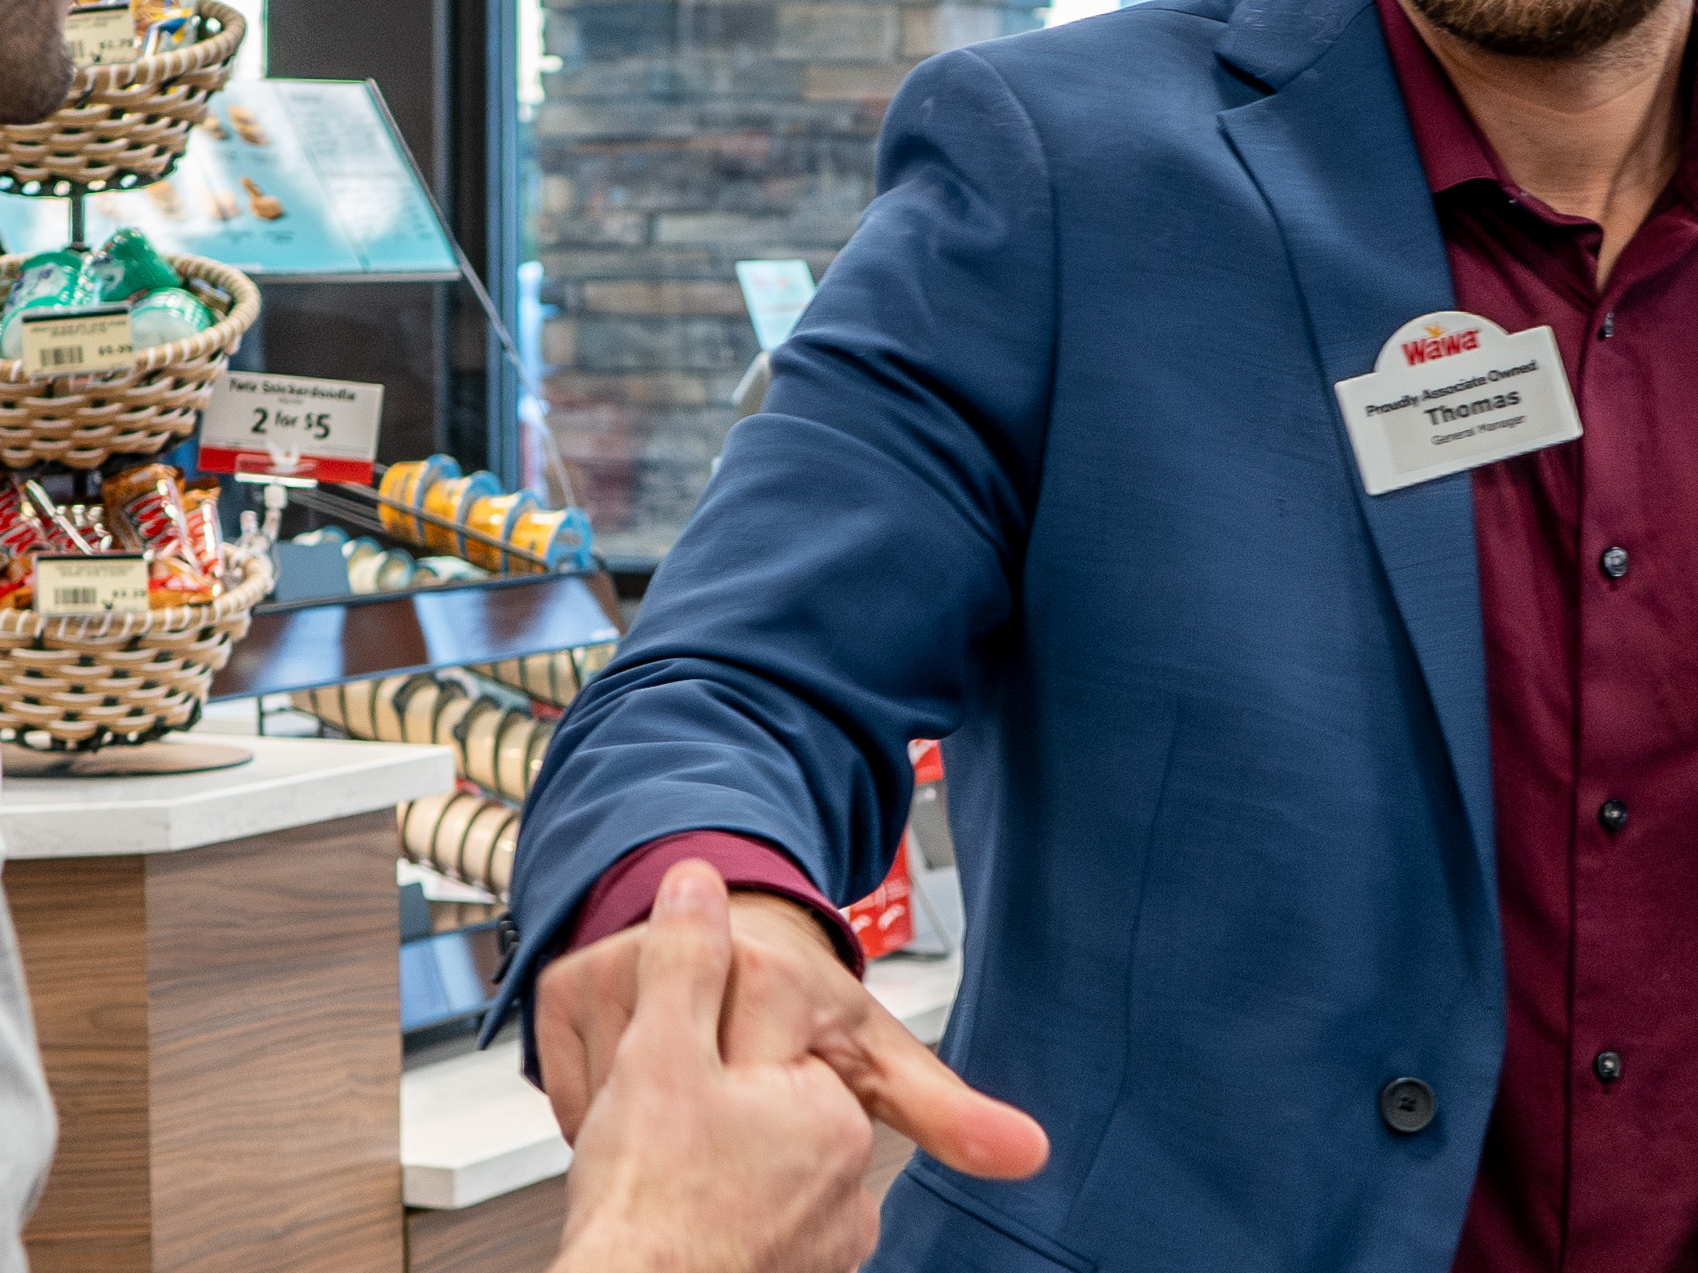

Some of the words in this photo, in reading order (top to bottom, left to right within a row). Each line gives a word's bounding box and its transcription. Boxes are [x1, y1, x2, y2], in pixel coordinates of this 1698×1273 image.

[1401, 329, 1482, 367] Wawa
[1364, 394, 1418, 418] Proudly
[1422, 377, 1487, 402] Associate
[1487, 360, 1539, 383] Owned
[251, 407, 269, 435] 2
[275, 411, 299, 428] for
[304, 411, 332, 440] $5
[1423, 390, 1522, 426] Thomas
[1431, 427, 1476, 446] General
[1477, 415, 1528, 434] Manager
